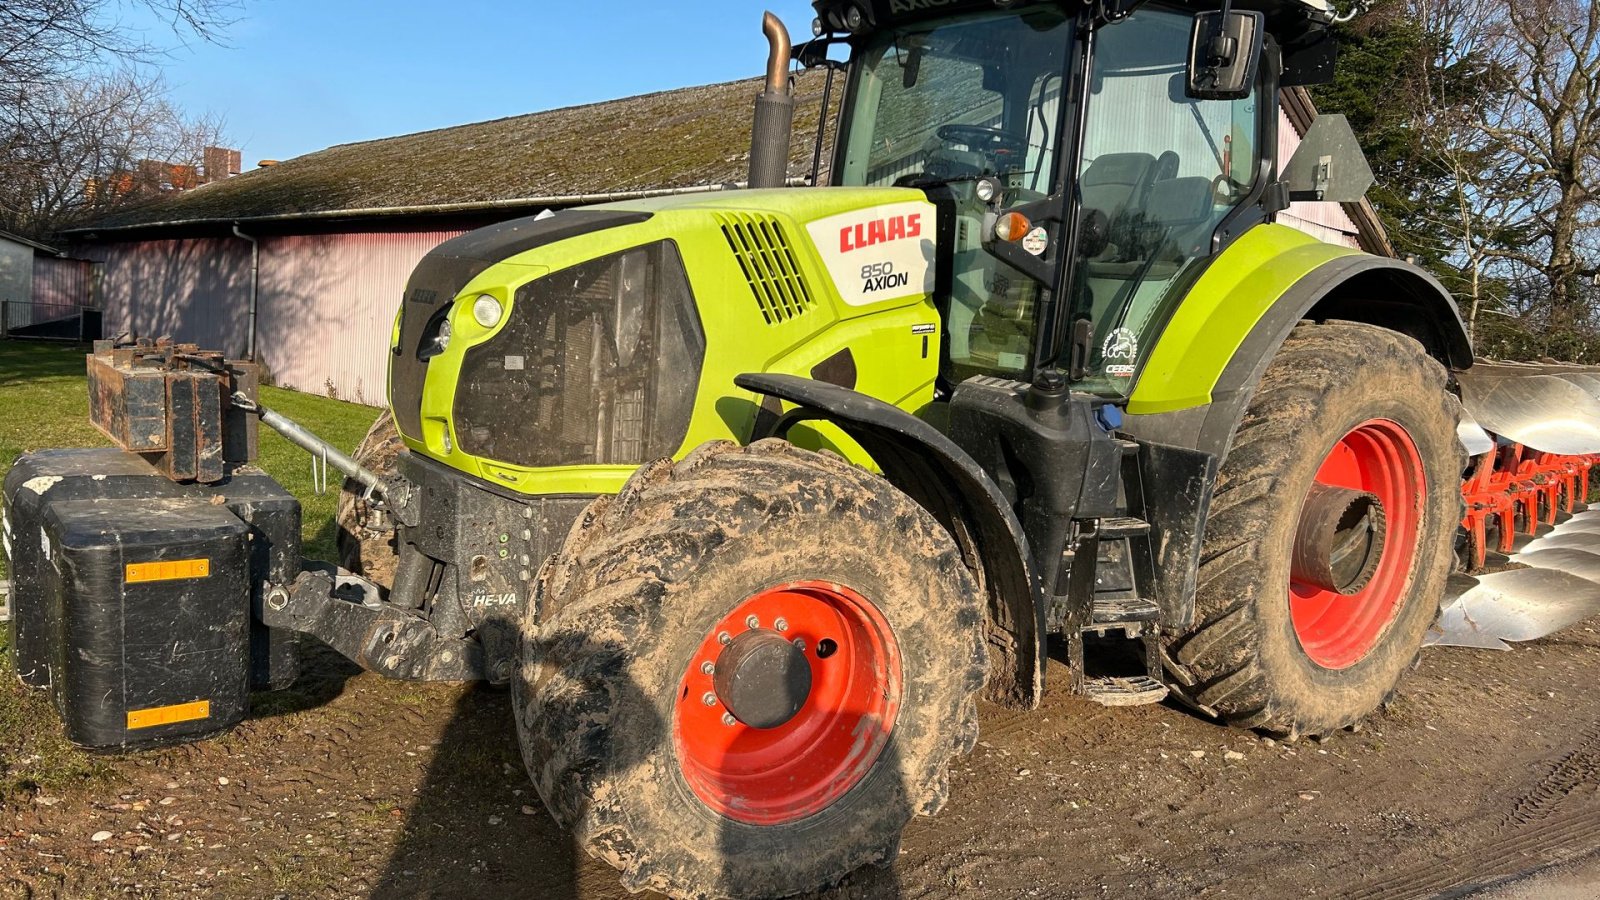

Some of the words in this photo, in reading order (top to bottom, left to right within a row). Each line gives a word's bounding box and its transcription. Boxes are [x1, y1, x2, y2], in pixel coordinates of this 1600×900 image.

[840, 213, 921, 253] CLAAS
[861, 261, 893, 279] 850
[862, 272, 909, 294] AXION
[1106, 364, 1136, 373] CEBIS
[473, 593, 517, 607] HE-VA
